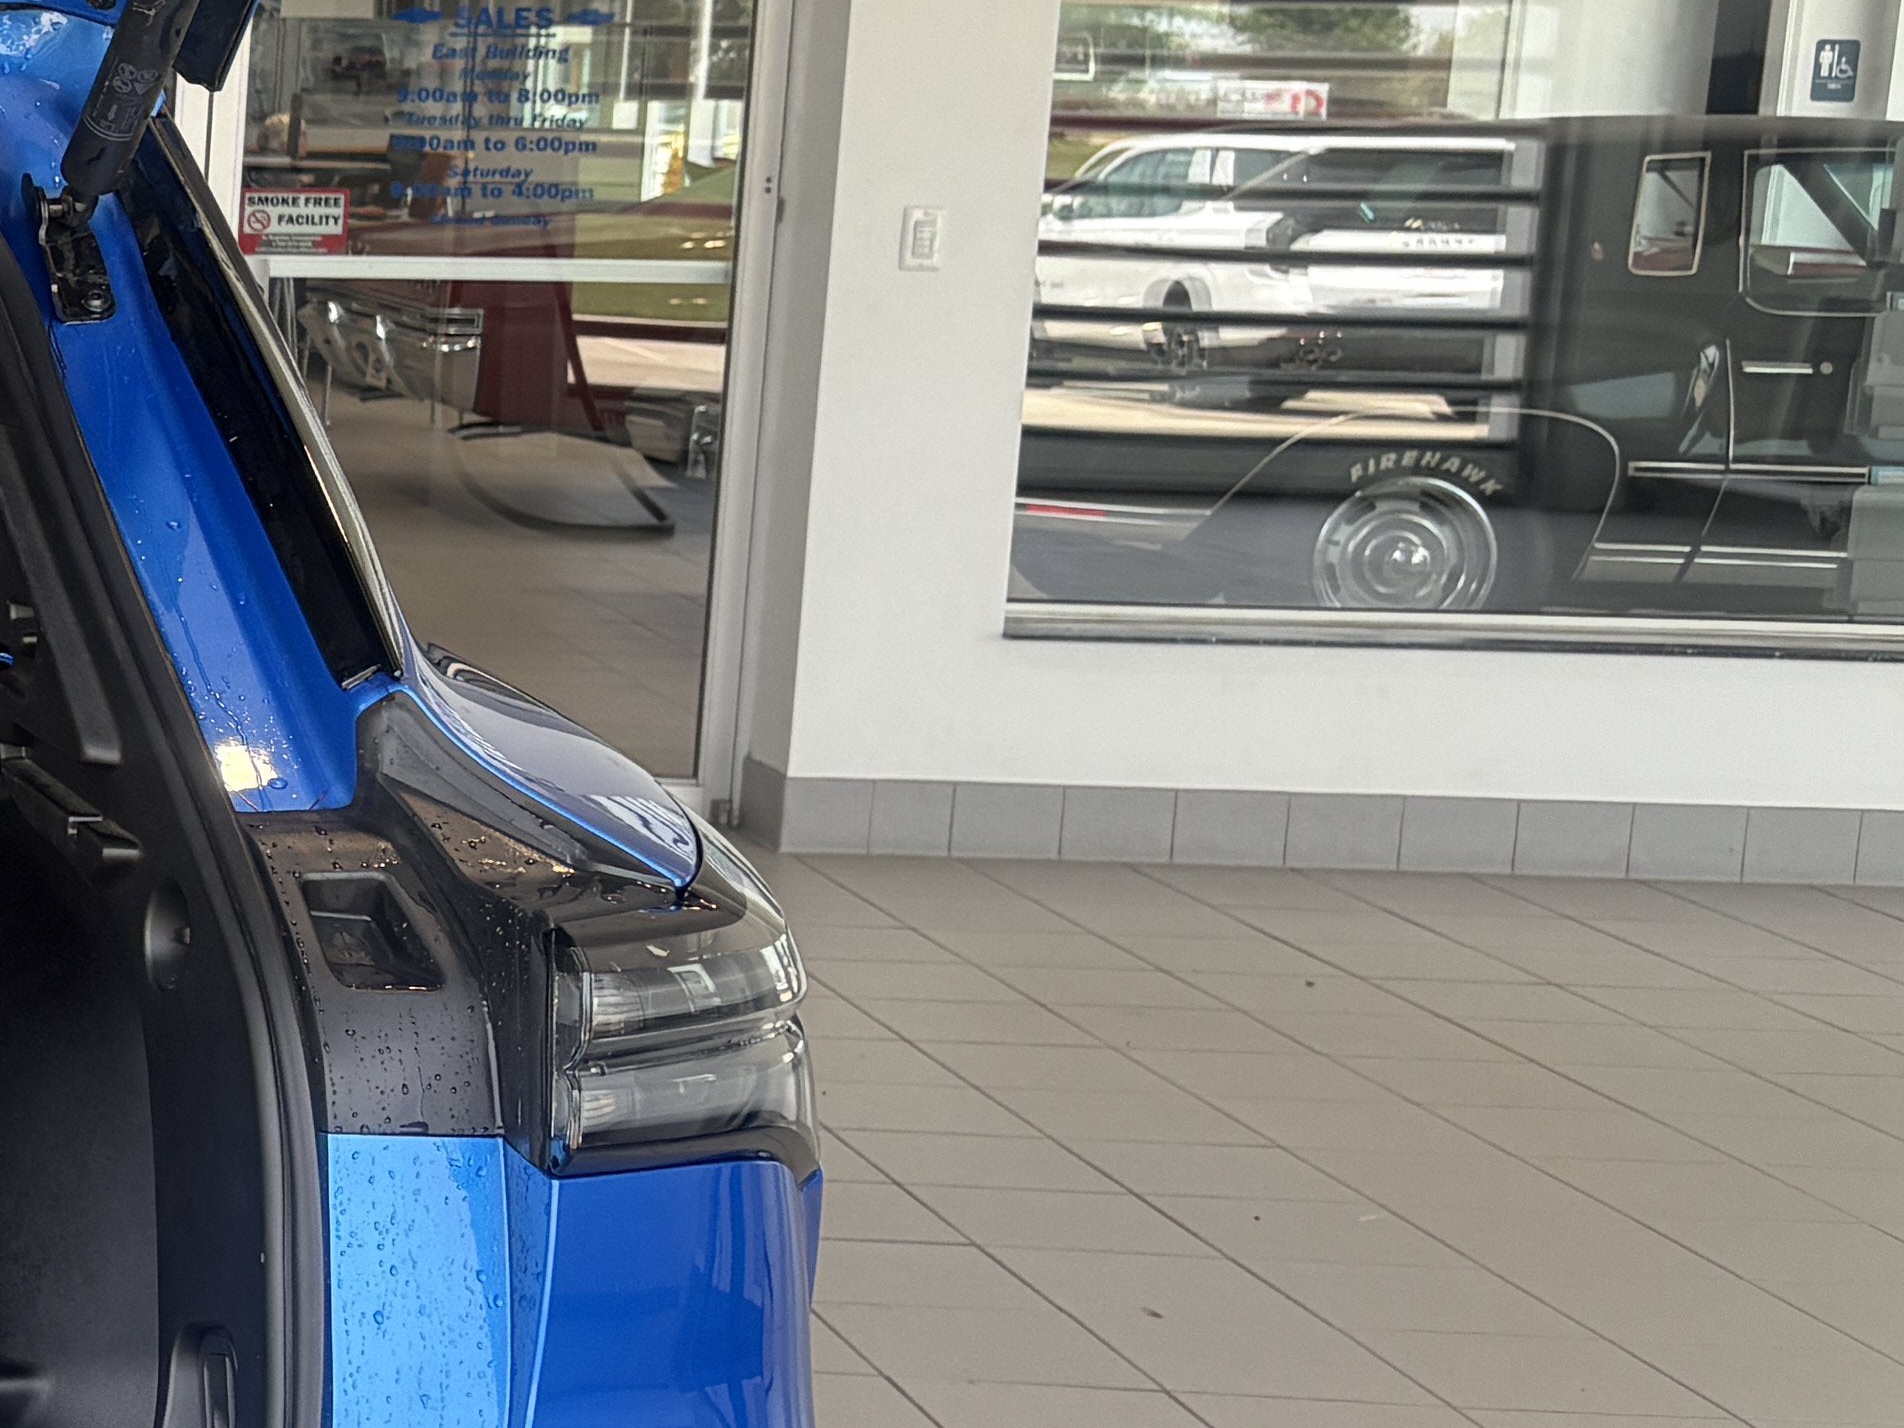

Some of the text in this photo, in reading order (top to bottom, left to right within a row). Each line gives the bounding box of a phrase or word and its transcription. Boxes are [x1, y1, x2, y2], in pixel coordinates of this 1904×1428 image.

[455, 7, 555, 29] SALES
[485, 43, 570, 64] Building
[484, 136, 506, 153] to
[515, 136, 598, 156] 6:00pm
[247, 196, 342, 208] SMOKE FREE
[481, 183, 503, 200] to
[511, 182, 595, 202] 4:00pm
[277, 213, 341, 226] FACILITY
[1350, 449, 1504, 496] FIREHAWK
